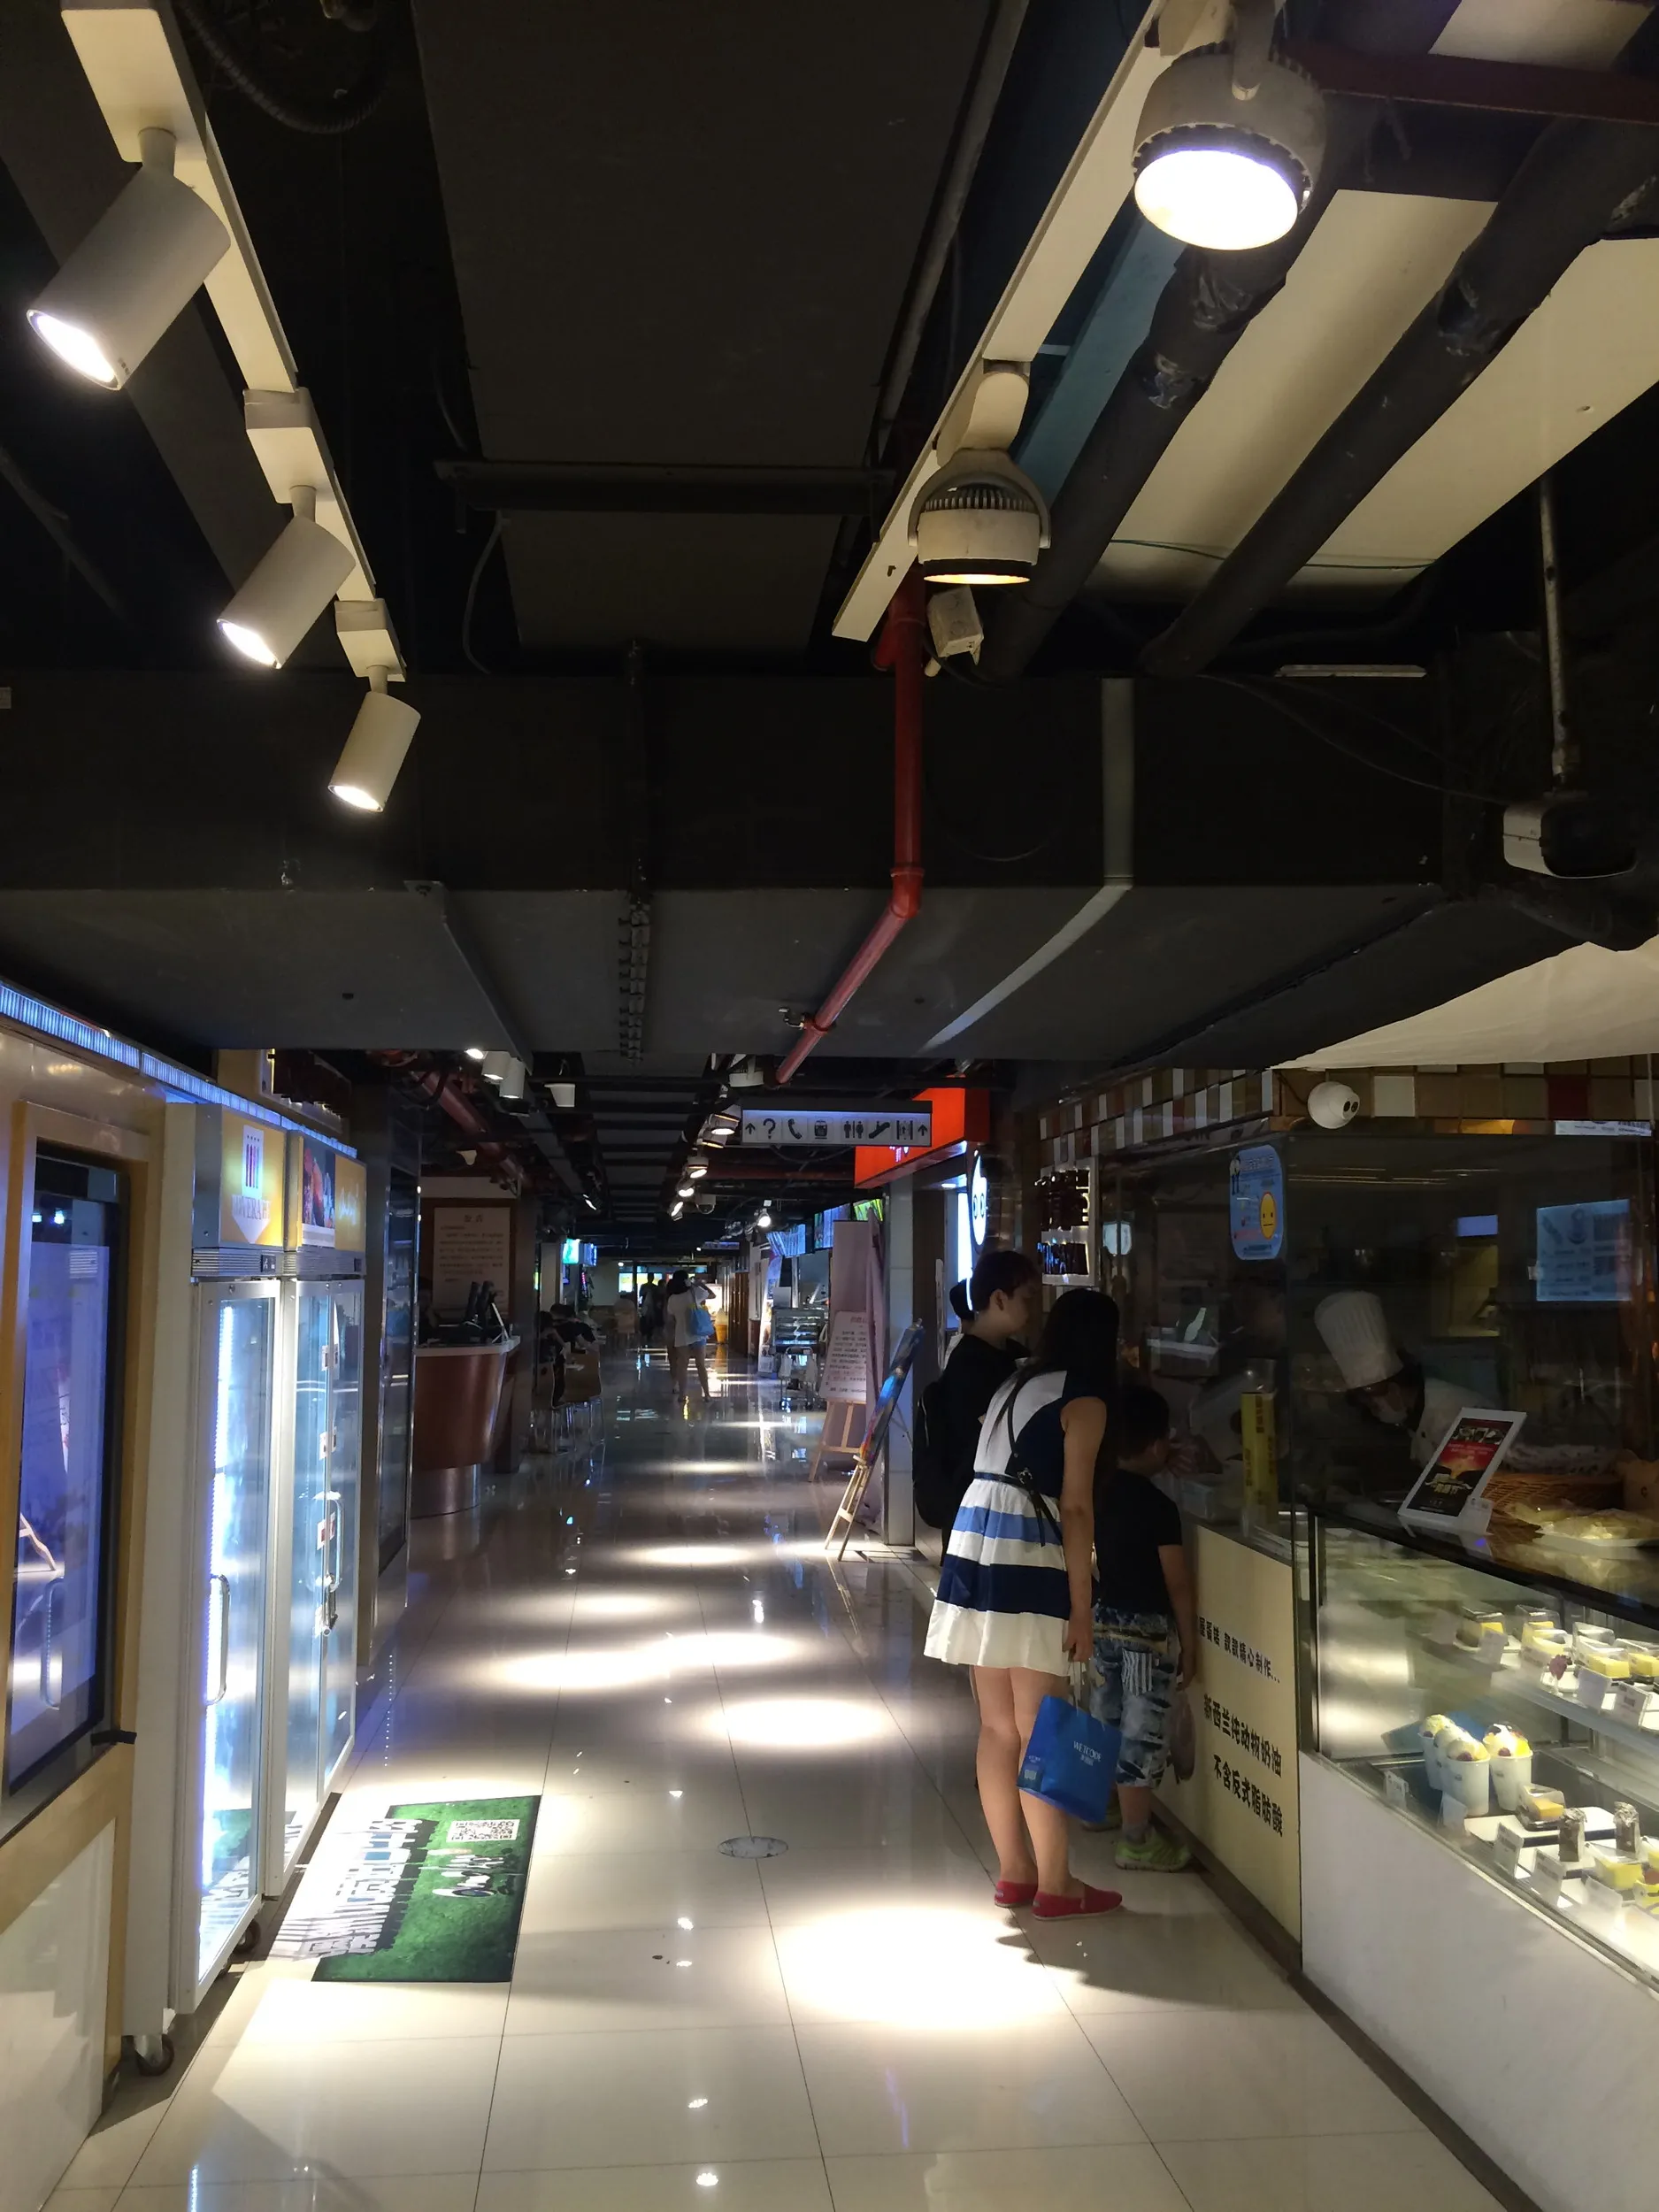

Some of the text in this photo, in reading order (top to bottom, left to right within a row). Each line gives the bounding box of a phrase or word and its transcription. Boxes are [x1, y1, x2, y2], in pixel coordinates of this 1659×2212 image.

[1073, 1740, 1102, 1763] WETCODE
[1204, 1694, 1282, 1778] 新西兰纯动物奶油
[1213, 1754, 1283, 1838] 不含反式脂肪酸
